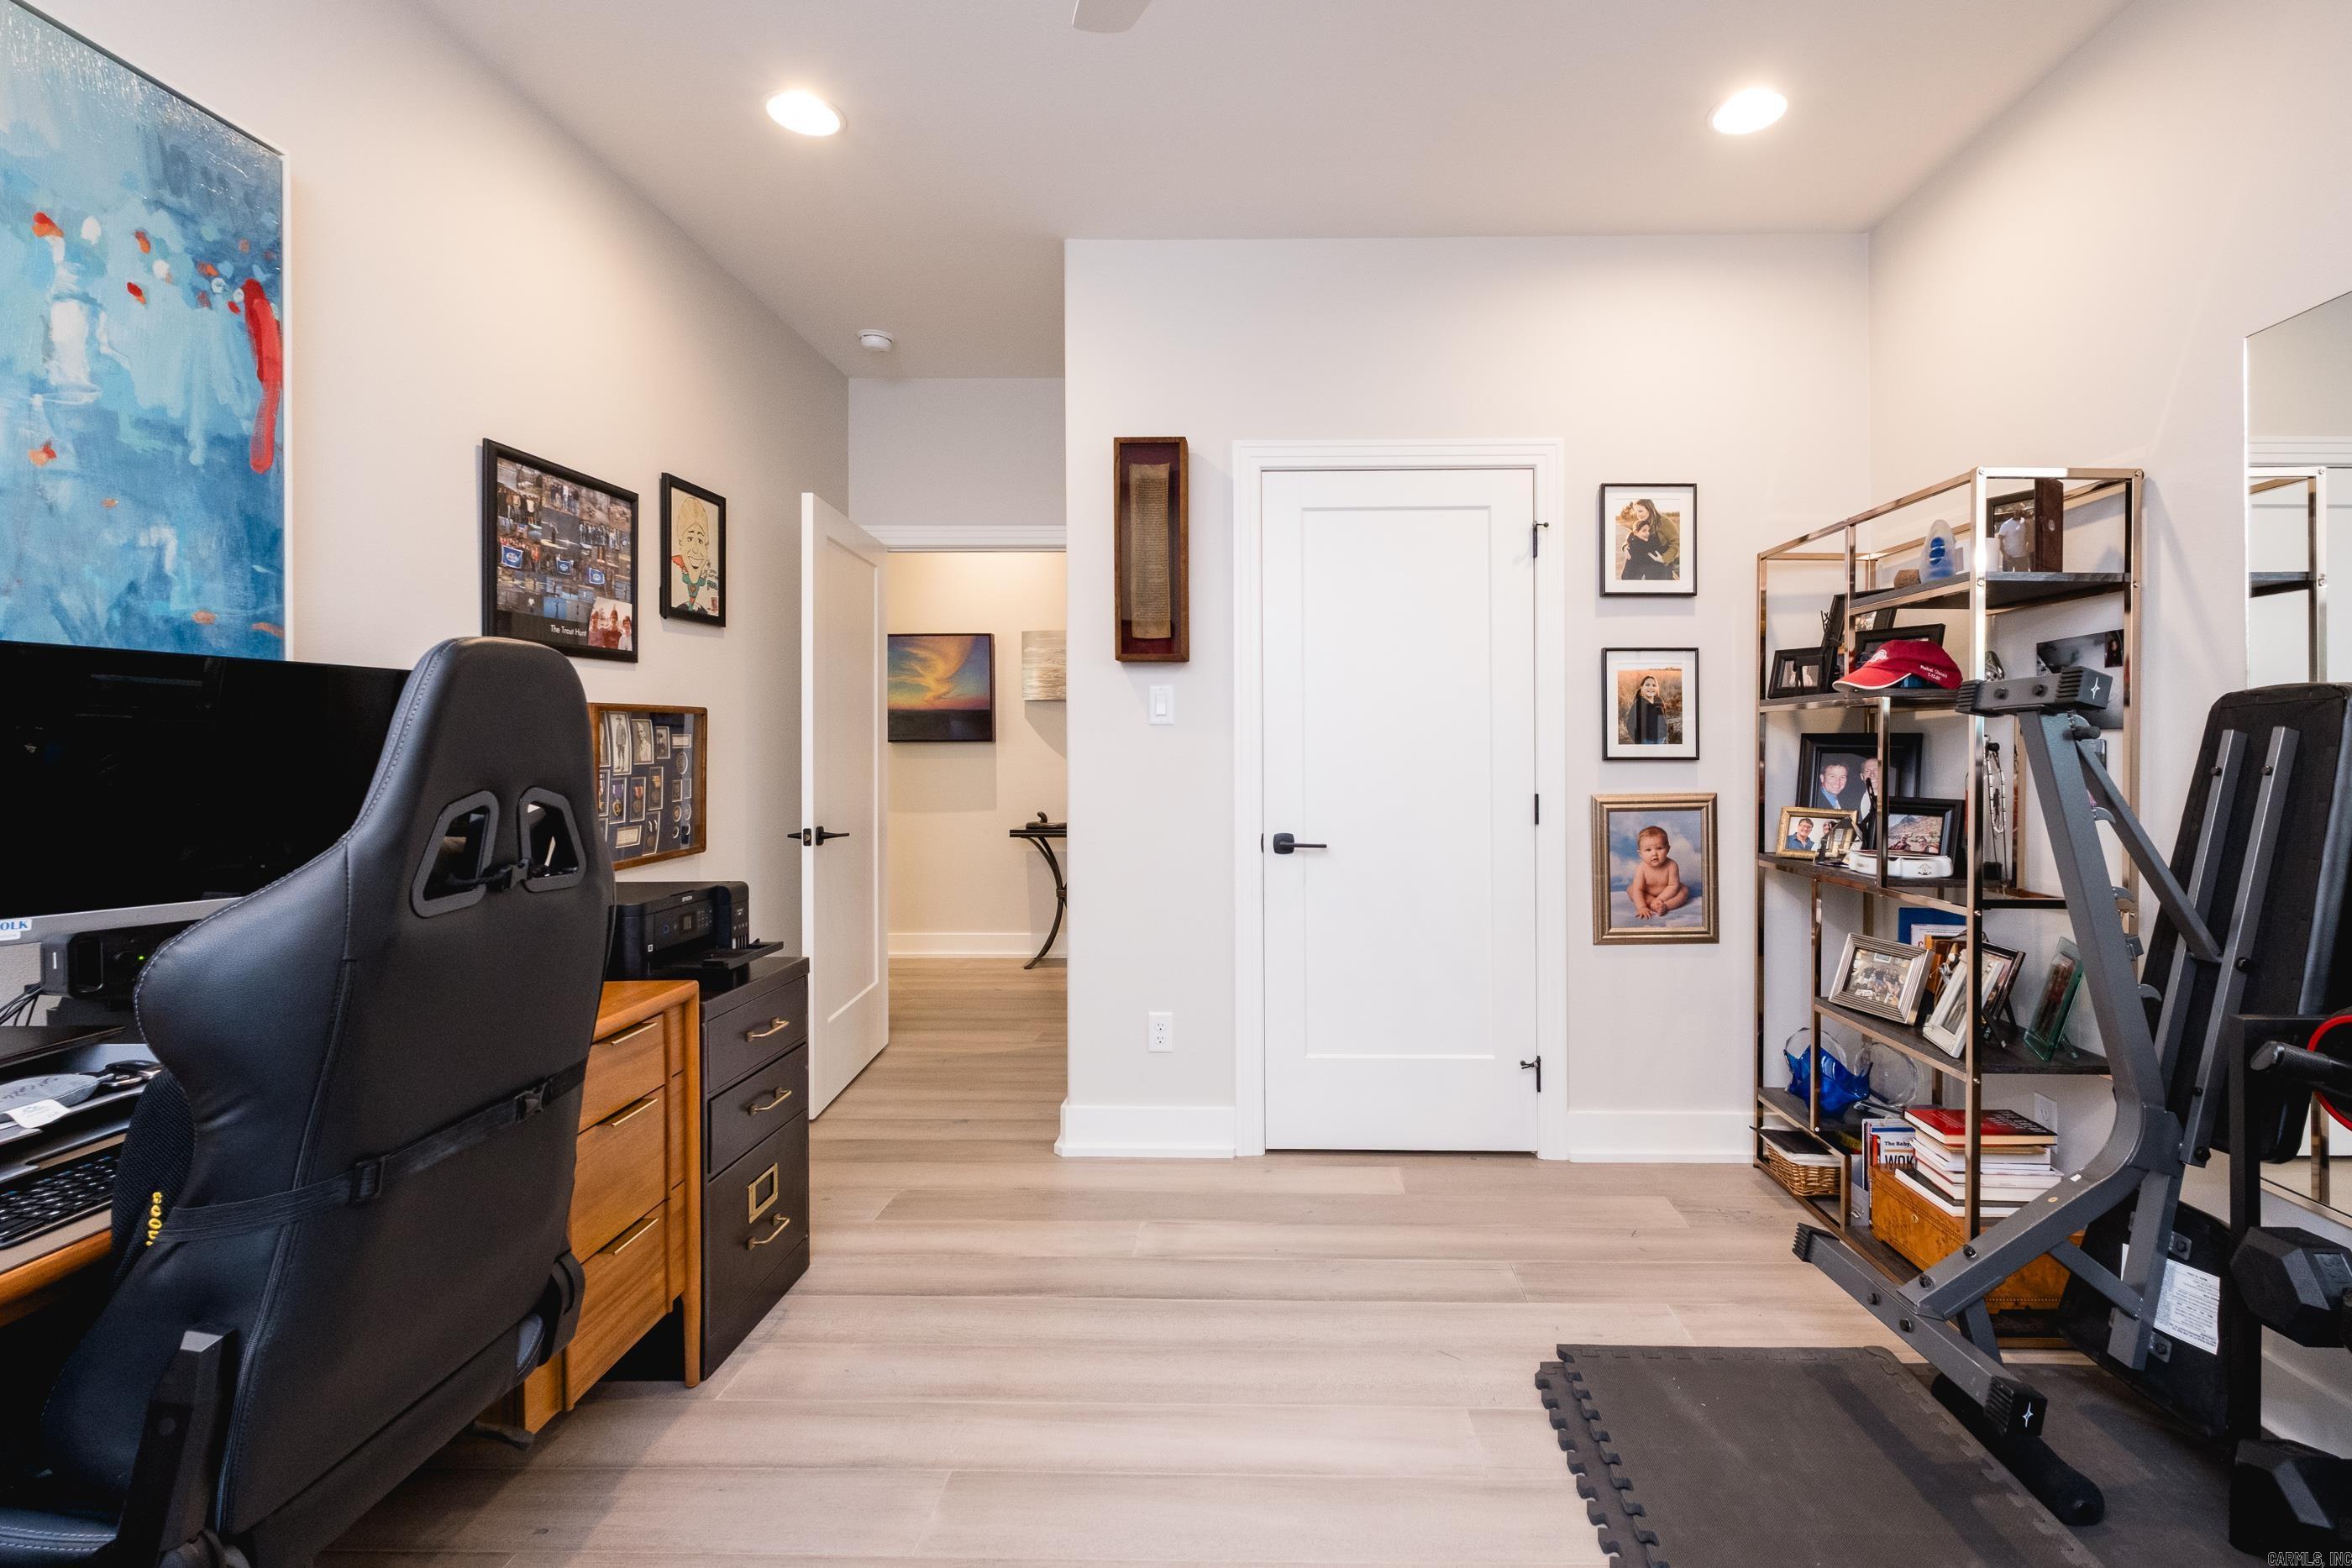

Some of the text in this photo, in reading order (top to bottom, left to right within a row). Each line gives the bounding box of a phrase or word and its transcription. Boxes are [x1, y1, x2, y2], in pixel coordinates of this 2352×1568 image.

[550, 624, 587, 637] The Trout Hunt
[0, 920, 28, 931] OLK
[1885, 1155, 1914, 1164] WOK
